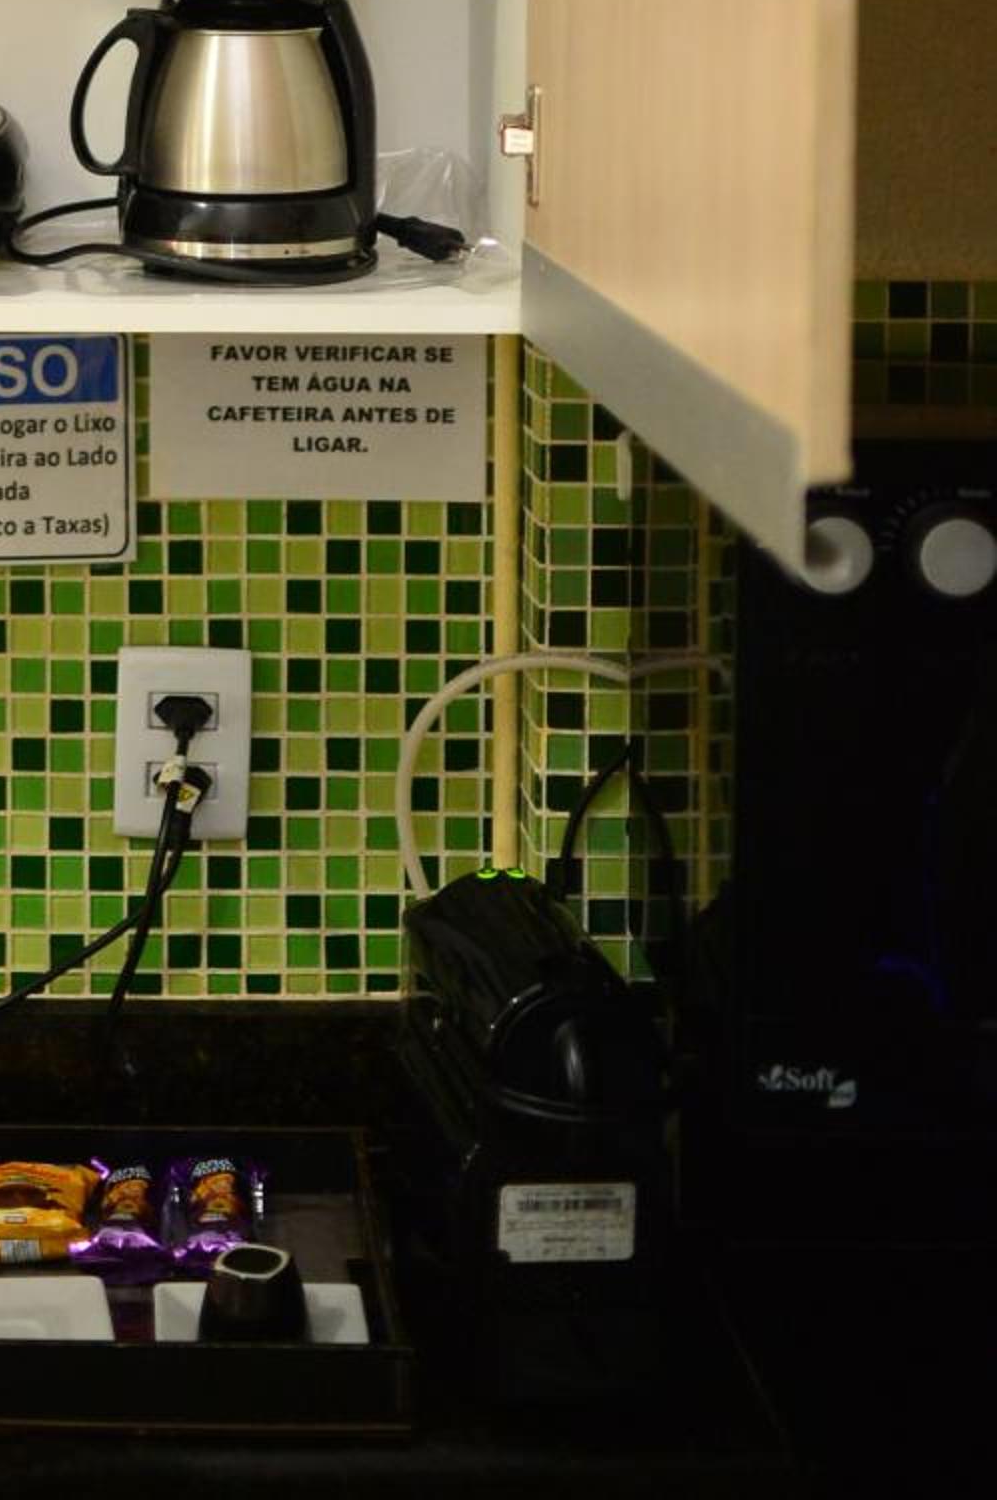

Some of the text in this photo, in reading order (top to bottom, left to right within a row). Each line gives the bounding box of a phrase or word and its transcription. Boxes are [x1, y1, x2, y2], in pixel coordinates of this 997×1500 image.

[210, 345, 454, 363] FAVOR VERIFICAR SE
[252, 373, 411, 393] TEM ÁGUA NA
[54, 420, 67, 433] o
[74, 412, 116, 433] Lixo
[208, 406, 455, 424] CAFETEIRA ANTES DE
[293, 437, 368, 453] LIGAR.
[35, 451, 60, 467] ao
[68, 446, 117, 466] Lado
[23, 520, 35, 535] a
[42, 513, 109, 537] Taxas)
